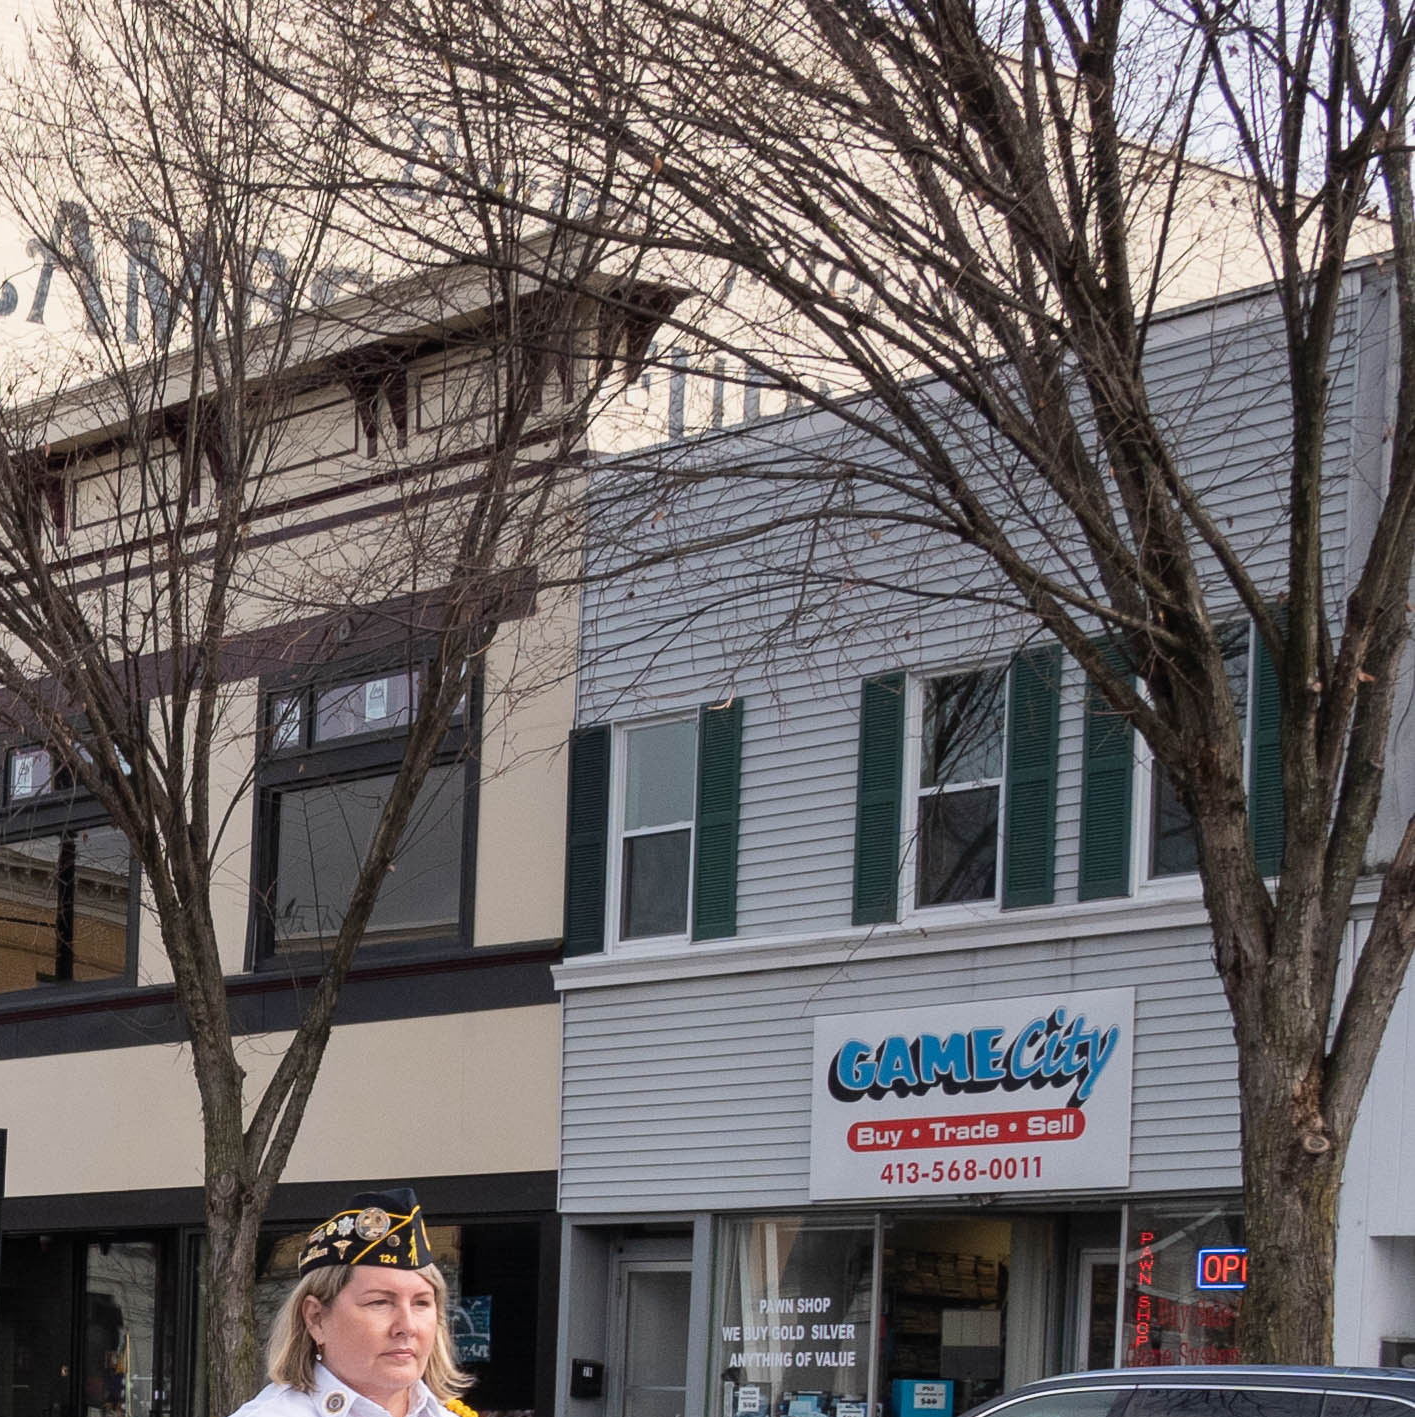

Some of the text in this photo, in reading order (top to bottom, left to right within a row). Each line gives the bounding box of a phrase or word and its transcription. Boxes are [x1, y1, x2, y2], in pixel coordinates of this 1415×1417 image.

[828, 1005, 1120, 1107] GAME City
[856, 1113, 1075, 1148] Buy Trade Sell
[880, 1155, 1043, 1185] 413-568-0011
[378, 1254, 398, 1264] 124
[1204, 1255, 1248, 1282] OP
[1136, 1231, 1154, 1348] PAWN SHOP
[759, 1297, 831, 1314] PAWN SHOP
[722, 1324, 856, 1341] WE BUY GOLD SILVER
[729, 1351, 856, 1368] ANYTHING OF VALUE
